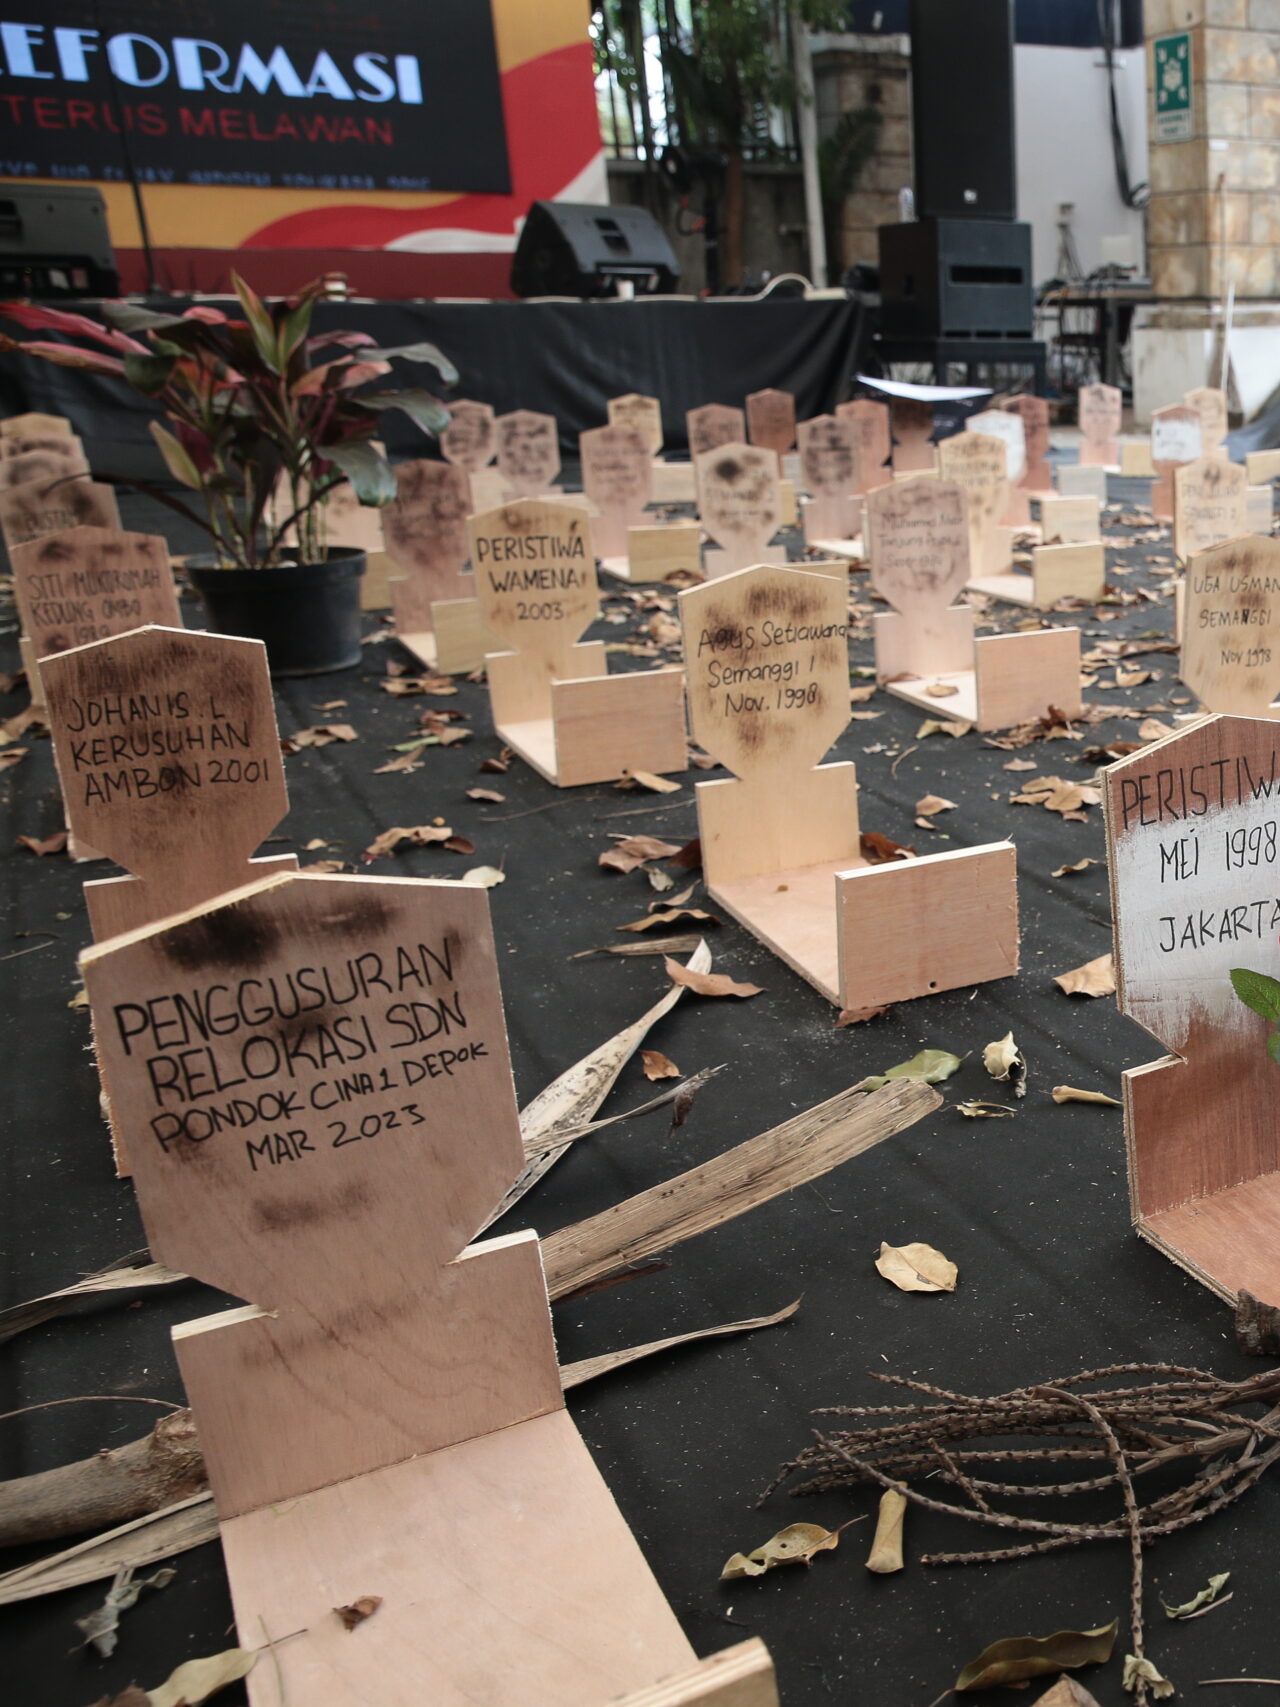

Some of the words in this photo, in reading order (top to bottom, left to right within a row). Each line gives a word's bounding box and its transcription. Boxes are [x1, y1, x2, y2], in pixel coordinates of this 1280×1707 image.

[0, 22, 423, 104] EFORMASI
[3, 94, 168, 135] TERUS
[179, 106, 394, 145] MELAWAN
[476, 535, 585, 562] PERISTIWA
[28, 574, 66, 601] SITI
[488, 567, 580, 594] WAMENA
[1193, 574, 1220, 594] UGA
[31, 600, 95, 627] KEDUNG
[517, 601, 564, 621] 2003
[1199, 608, 1272, 629] SEMANGGI
[708, 659, 800, 689] Semanggi
[1245, 648, 1272, 667] 1998
[725, 692, 770, 717] Nov.
[777, 682, 818, 710] 1998
[70, 722, 250, 772] KERUSUHAN
[84, 764, 202, 806] AMBON
[208, 759, 270, 785] 2001
[1225, 821, 1277, 871] 1998
[114, 937, 454, 1056] PENGGUSURAN
[146, 1015, 378, 1107] RELOKASI
[385, 991, 468, 1049] SDN
[149, 1091, 305, 1153] PONDOK
[401, 1040, 489, 1087] DEPOK
[245, 1129, 316, 1172] MAR
[327, 1104, 427, 1149] 2023
